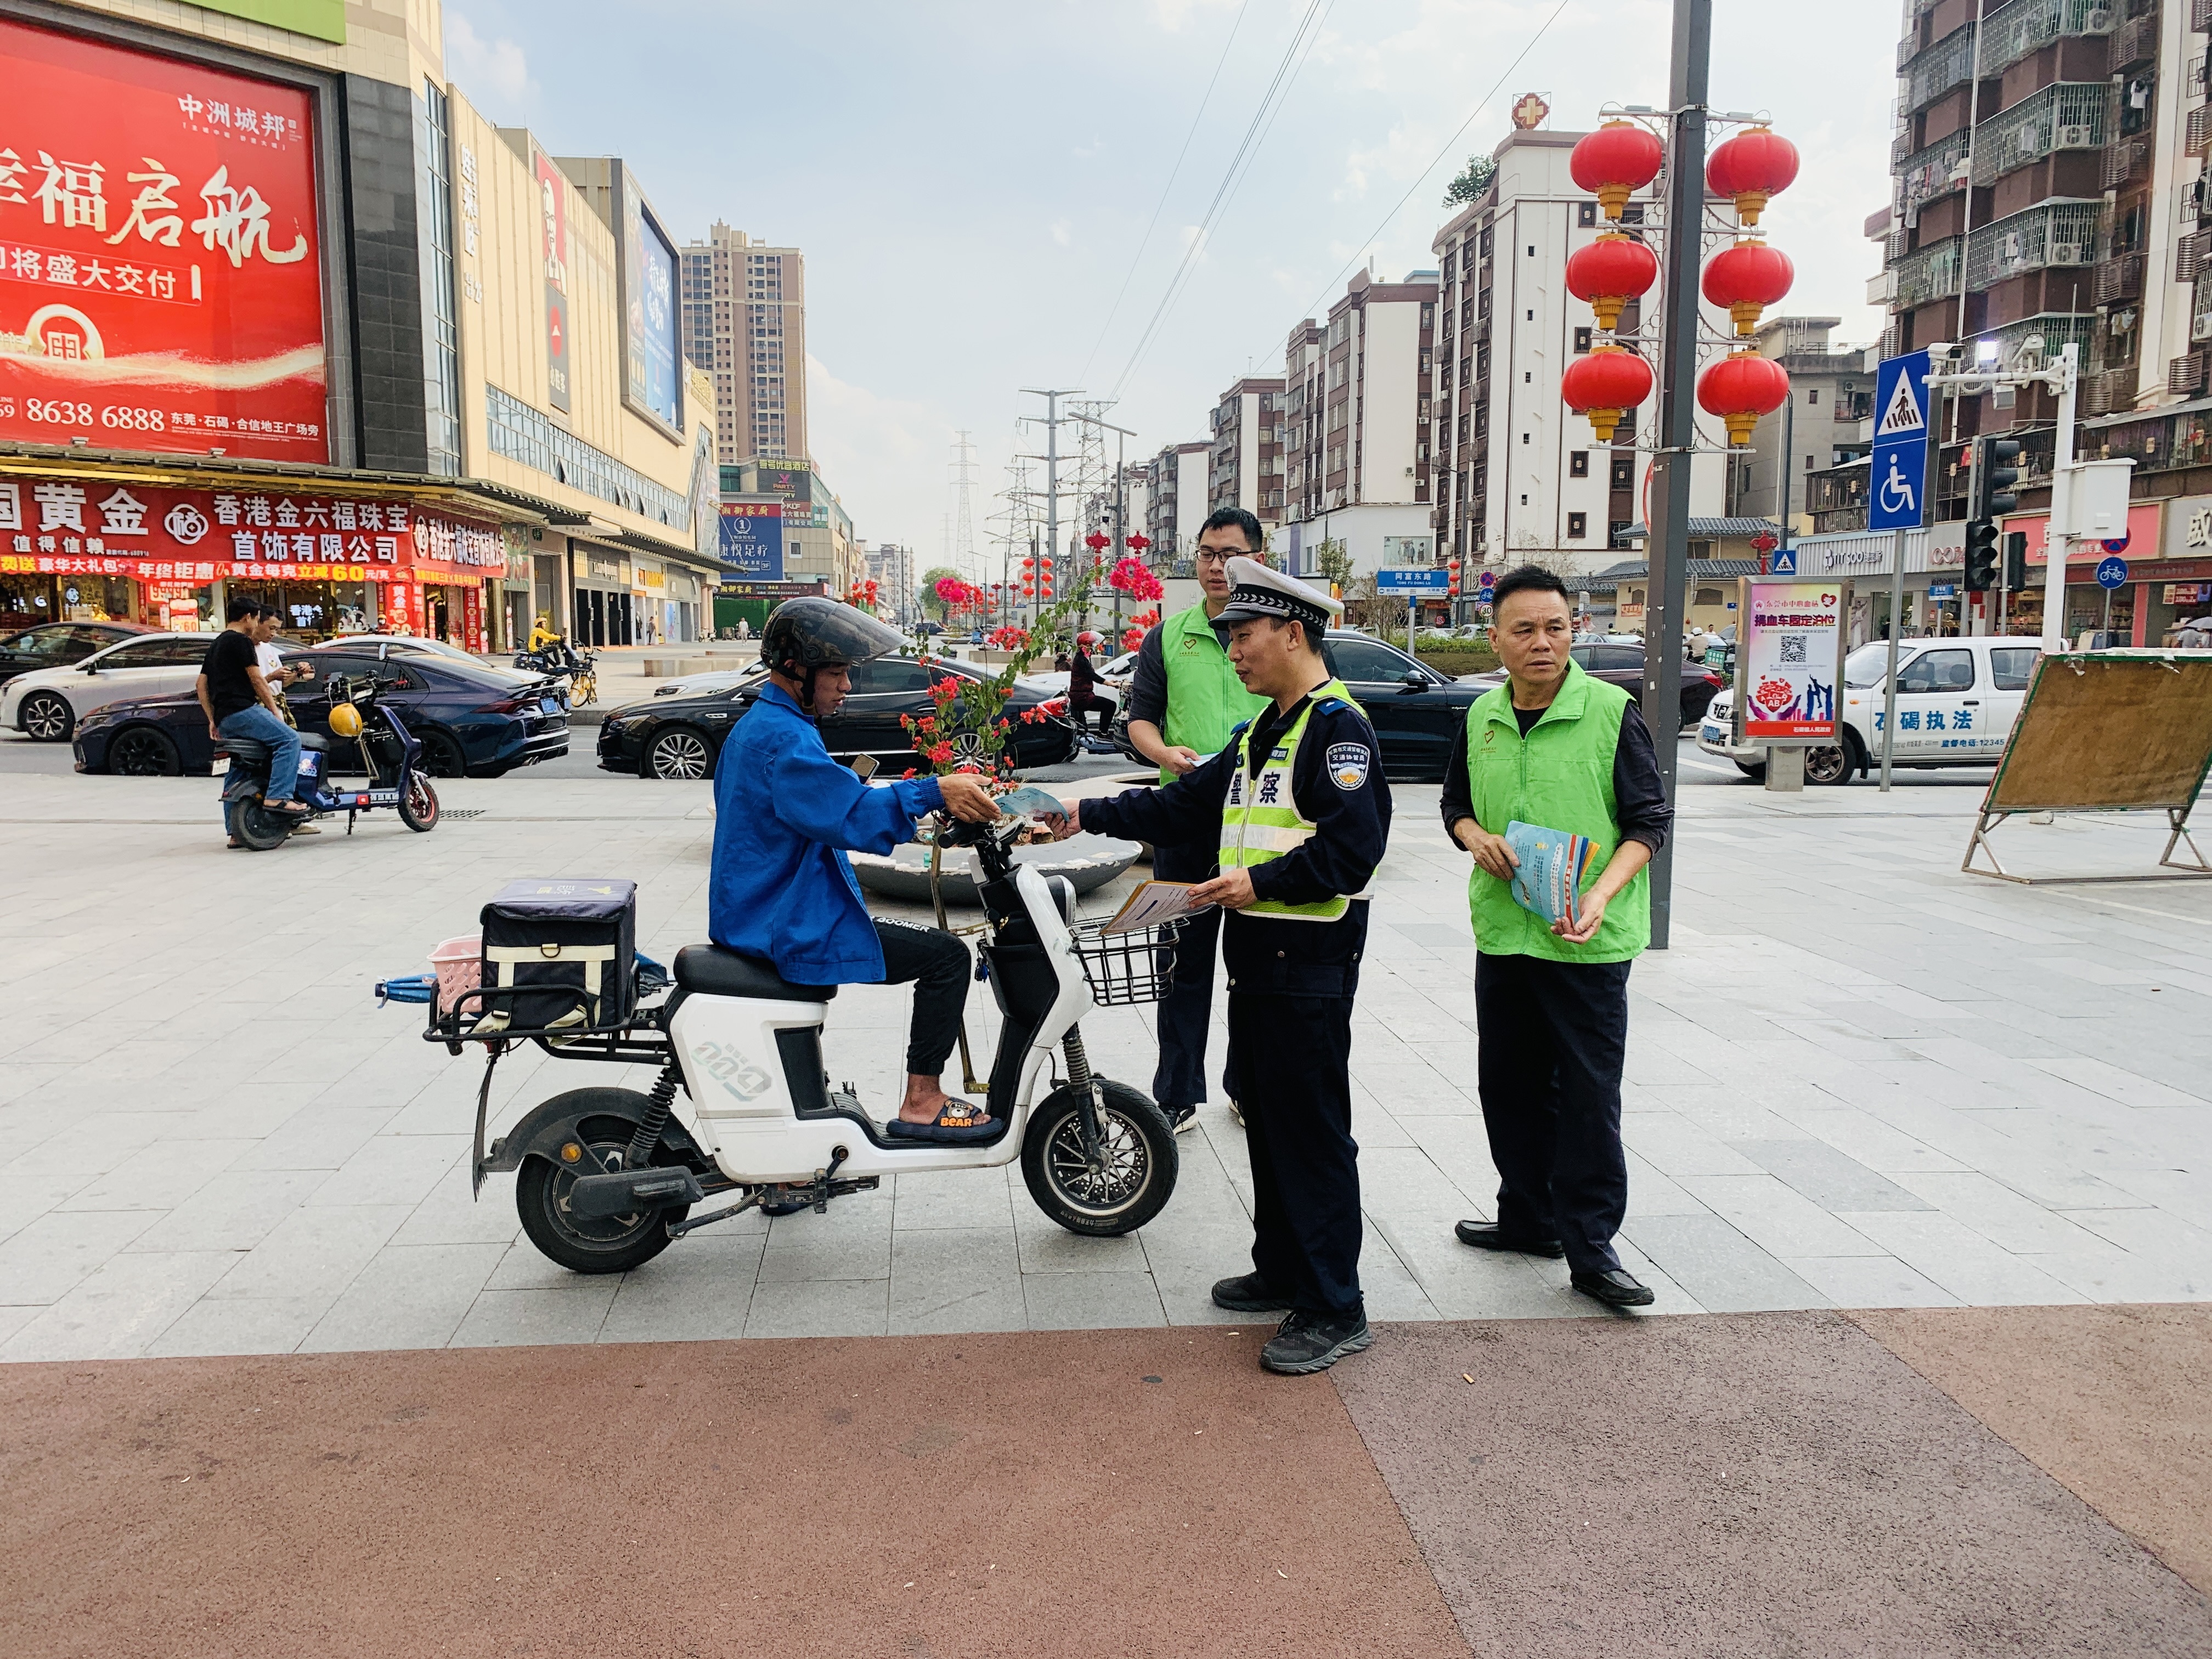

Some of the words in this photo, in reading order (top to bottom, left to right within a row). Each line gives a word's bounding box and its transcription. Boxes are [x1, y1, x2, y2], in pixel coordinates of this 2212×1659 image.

[177, 93, 285, 140] 中洲城邦
[0, 246, 177, 300] 将盛大交付
[550, 365, 565, 393] 必胜客
[26, 398, 94, 426] 8638
[101, 405, 165, 432] 6888
[759, 459, 810, 472] 壹号优客酒店
[213, 494, 410, 532] 香港金六福珠宝
[12, 534, 105, 555] 值得信赖
[231, 529, 398, 564] 首饰有限公司
[720, 543, 768, 557] 康悦足疗
[137, 561, 215, 580] 年终钜惠
[1395, 572, 1431, 580] 同富东路
[392, 585, 407, 609] 黄金
[1765, 600, 1819, 608] 东莞市中心血站
[1754, 614, 1836, 627] 捐血车固定泊位
[1940, 738, 2005, 748] 监督电话:12345
[1332, 754, 1365, 762] 交通协管员
